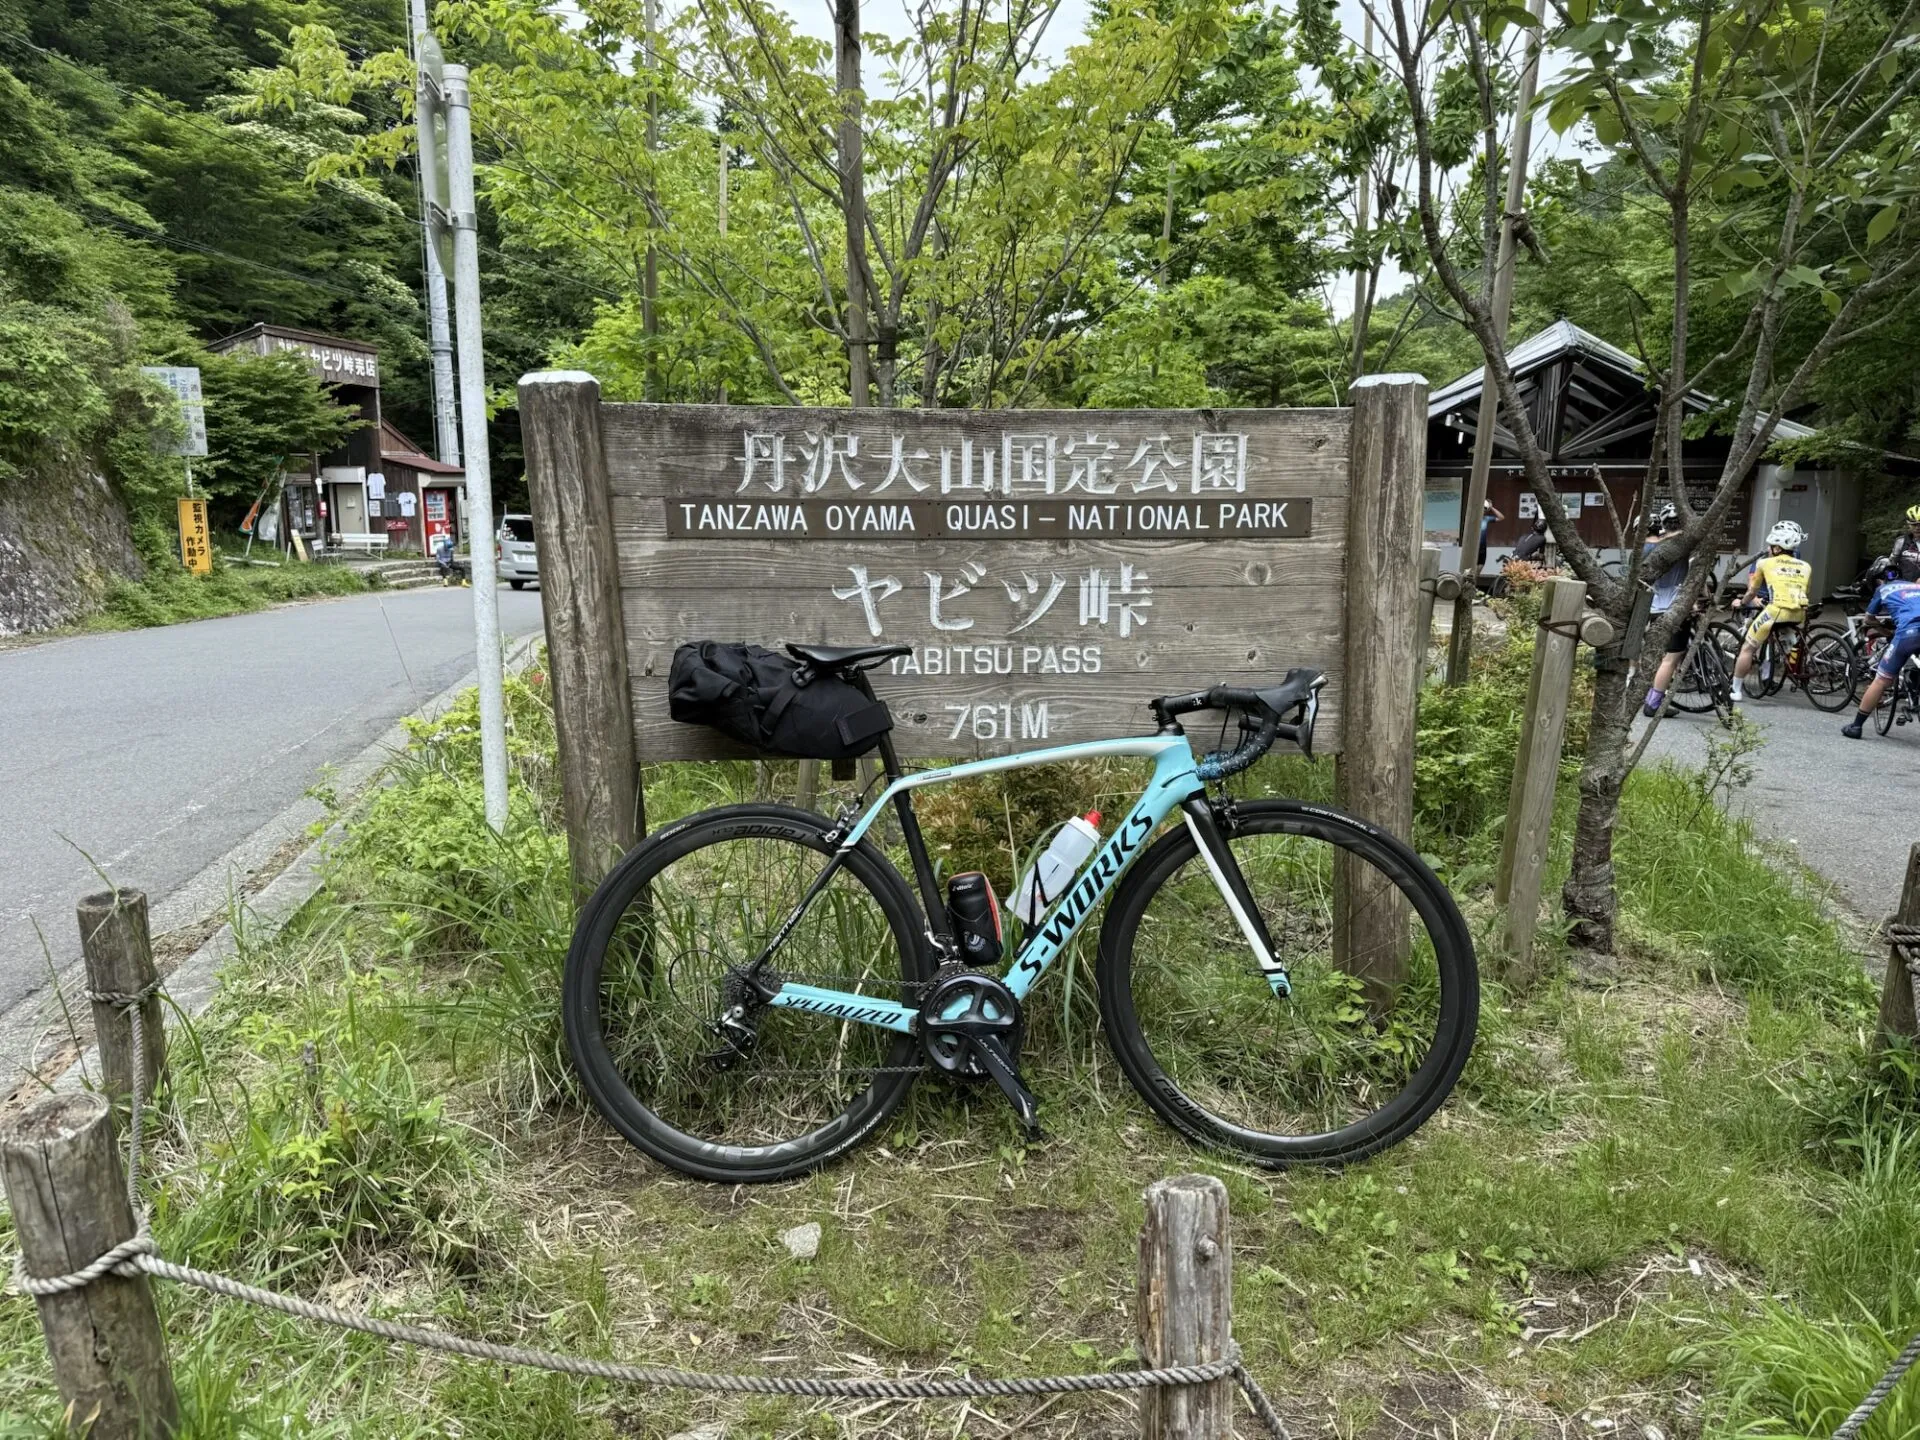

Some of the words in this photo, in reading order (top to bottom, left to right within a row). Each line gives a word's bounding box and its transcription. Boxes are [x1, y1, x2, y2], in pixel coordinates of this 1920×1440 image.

[733, 429, 1249, 494] 丹沢大山国定公園
[680, 503, 808, 530] TANZAWA
[825, 504, 915, 530] OYAMA
[1068, 503, 1210, 530] NATIONAL
[1218, 502, 1289, 529] PARK
[831, 560, 1153, 638] ヤビツ峠
[1023, 646, 1101, 674] PASS
[1019, 803, 1153, 986] S-WORKS
[785, 995, 902, 1025] SPECIALIZED
[825, 1111, 882, 1157] CONTINENTAL
